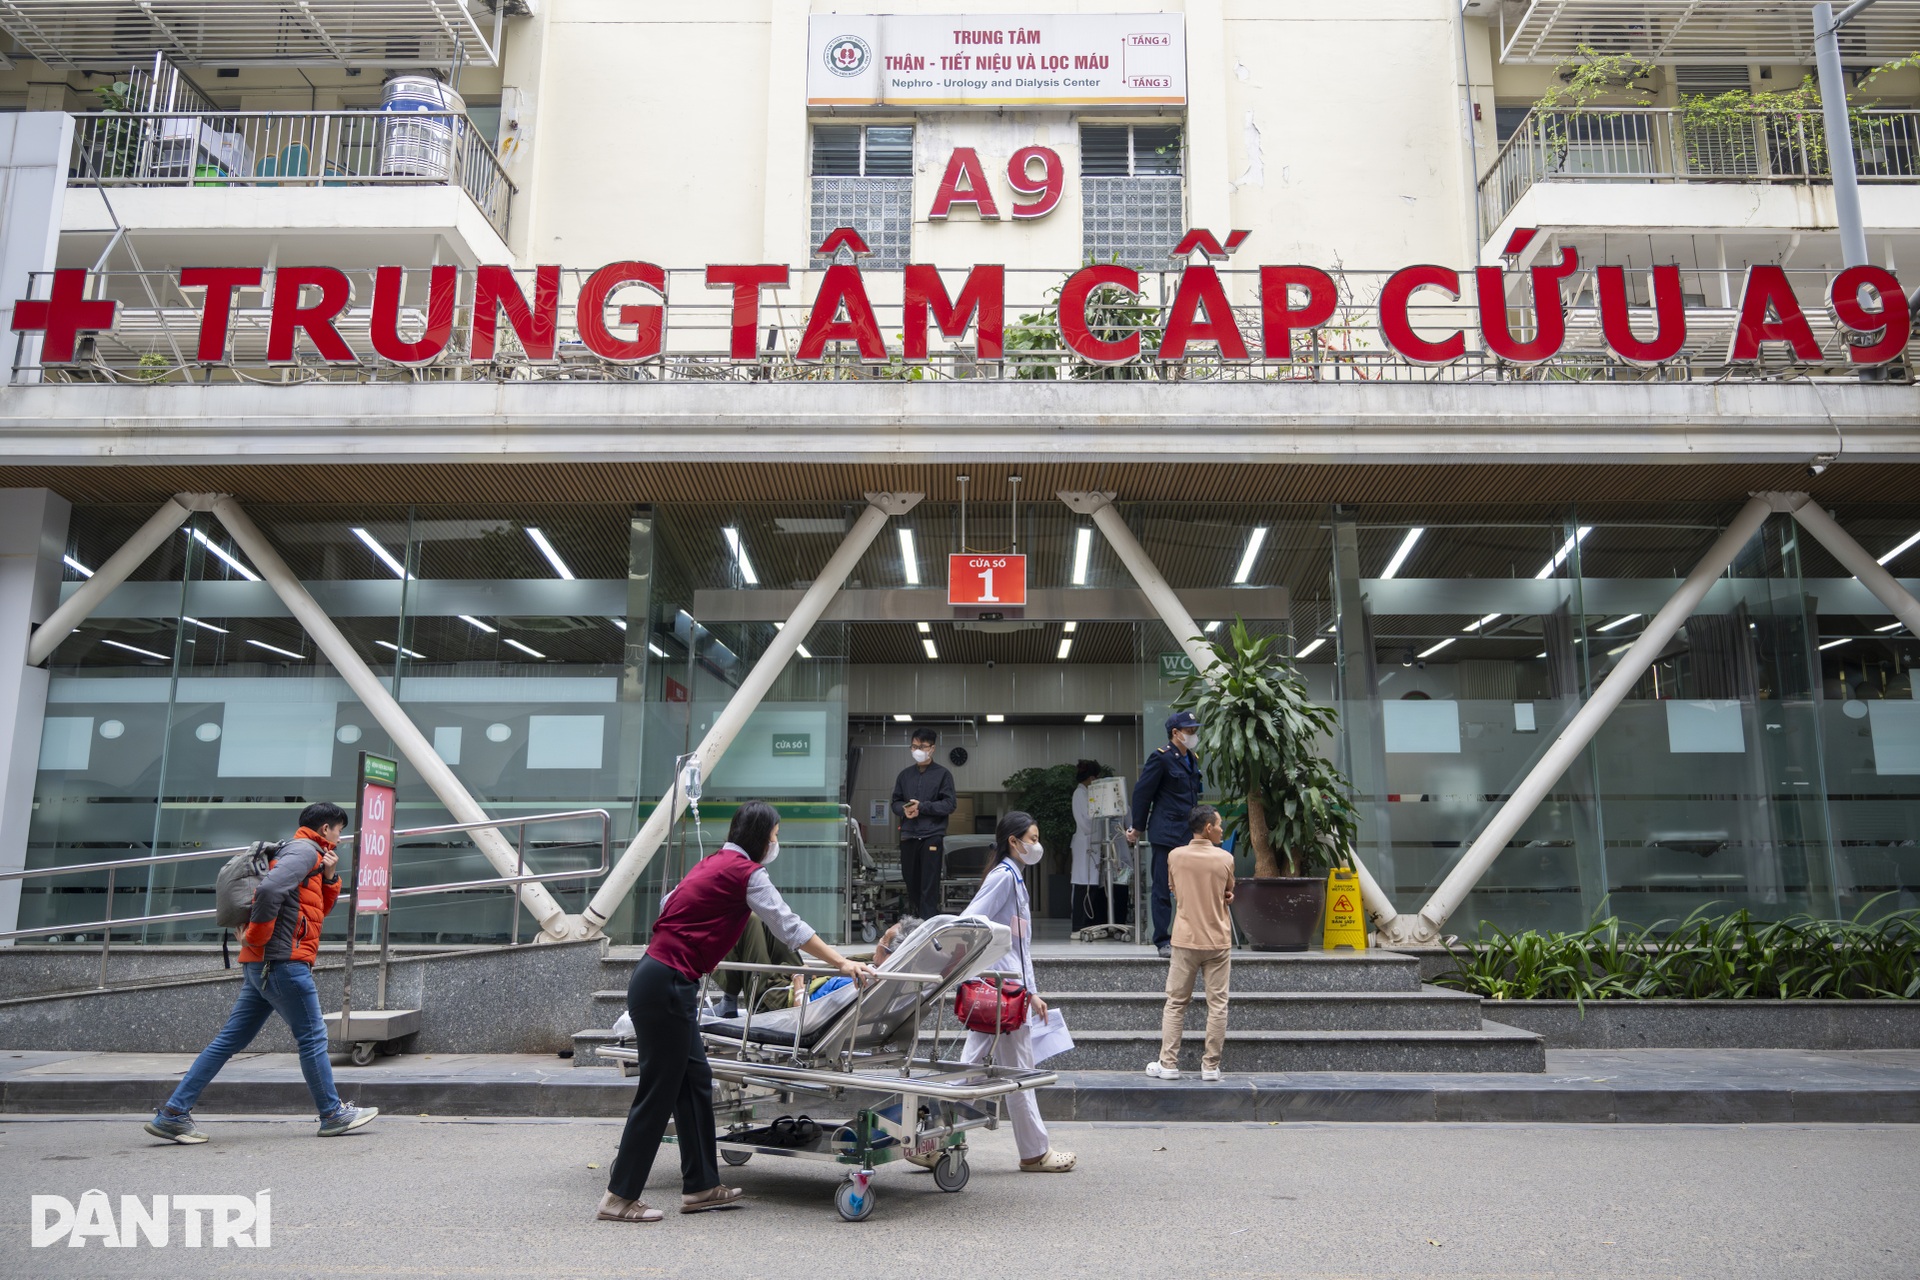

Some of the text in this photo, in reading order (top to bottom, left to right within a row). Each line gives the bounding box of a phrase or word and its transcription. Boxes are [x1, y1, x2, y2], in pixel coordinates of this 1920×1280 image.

[953, 27, 1041, 44] TRUNG TÂM
[1161, 36, 1168, 45] 4
[885, 53, 925, 73] THẬN
[940, 50, 971, 70] TIẾT
[976, 53, 1012, 73] NIỆU
[1016, 53, 1036, 70] VÀ
[1040, 55, 1069, 73] LỌC
[1074, 53, 1109, 70] MÁU
[891, 78, 934, 89] Nephro
[943, 78, 988, 89] Urology
[991, 78, 1012, 87] and
[1015, 78, 1060, 89] Dialysis
[1063, 78, 1100, 87] Center
[1162, 78, 1169, 87] 3
[928, 146, 1066, 221] A9
[179, 227, 1911, 367] TRUNG TÂM CẤP CỨU A9
[969, 557, 990, 568] CỬA
[978, 568, 999, 601] 1
[1162, 656, 1193, 670] WC
[775, 740, 791, 749] CỬA
[368, 793, 385, 821] LỐI
[364, 829, 386, 856] VÀO
[358, 864, 388, 887] CẤP CỨU
